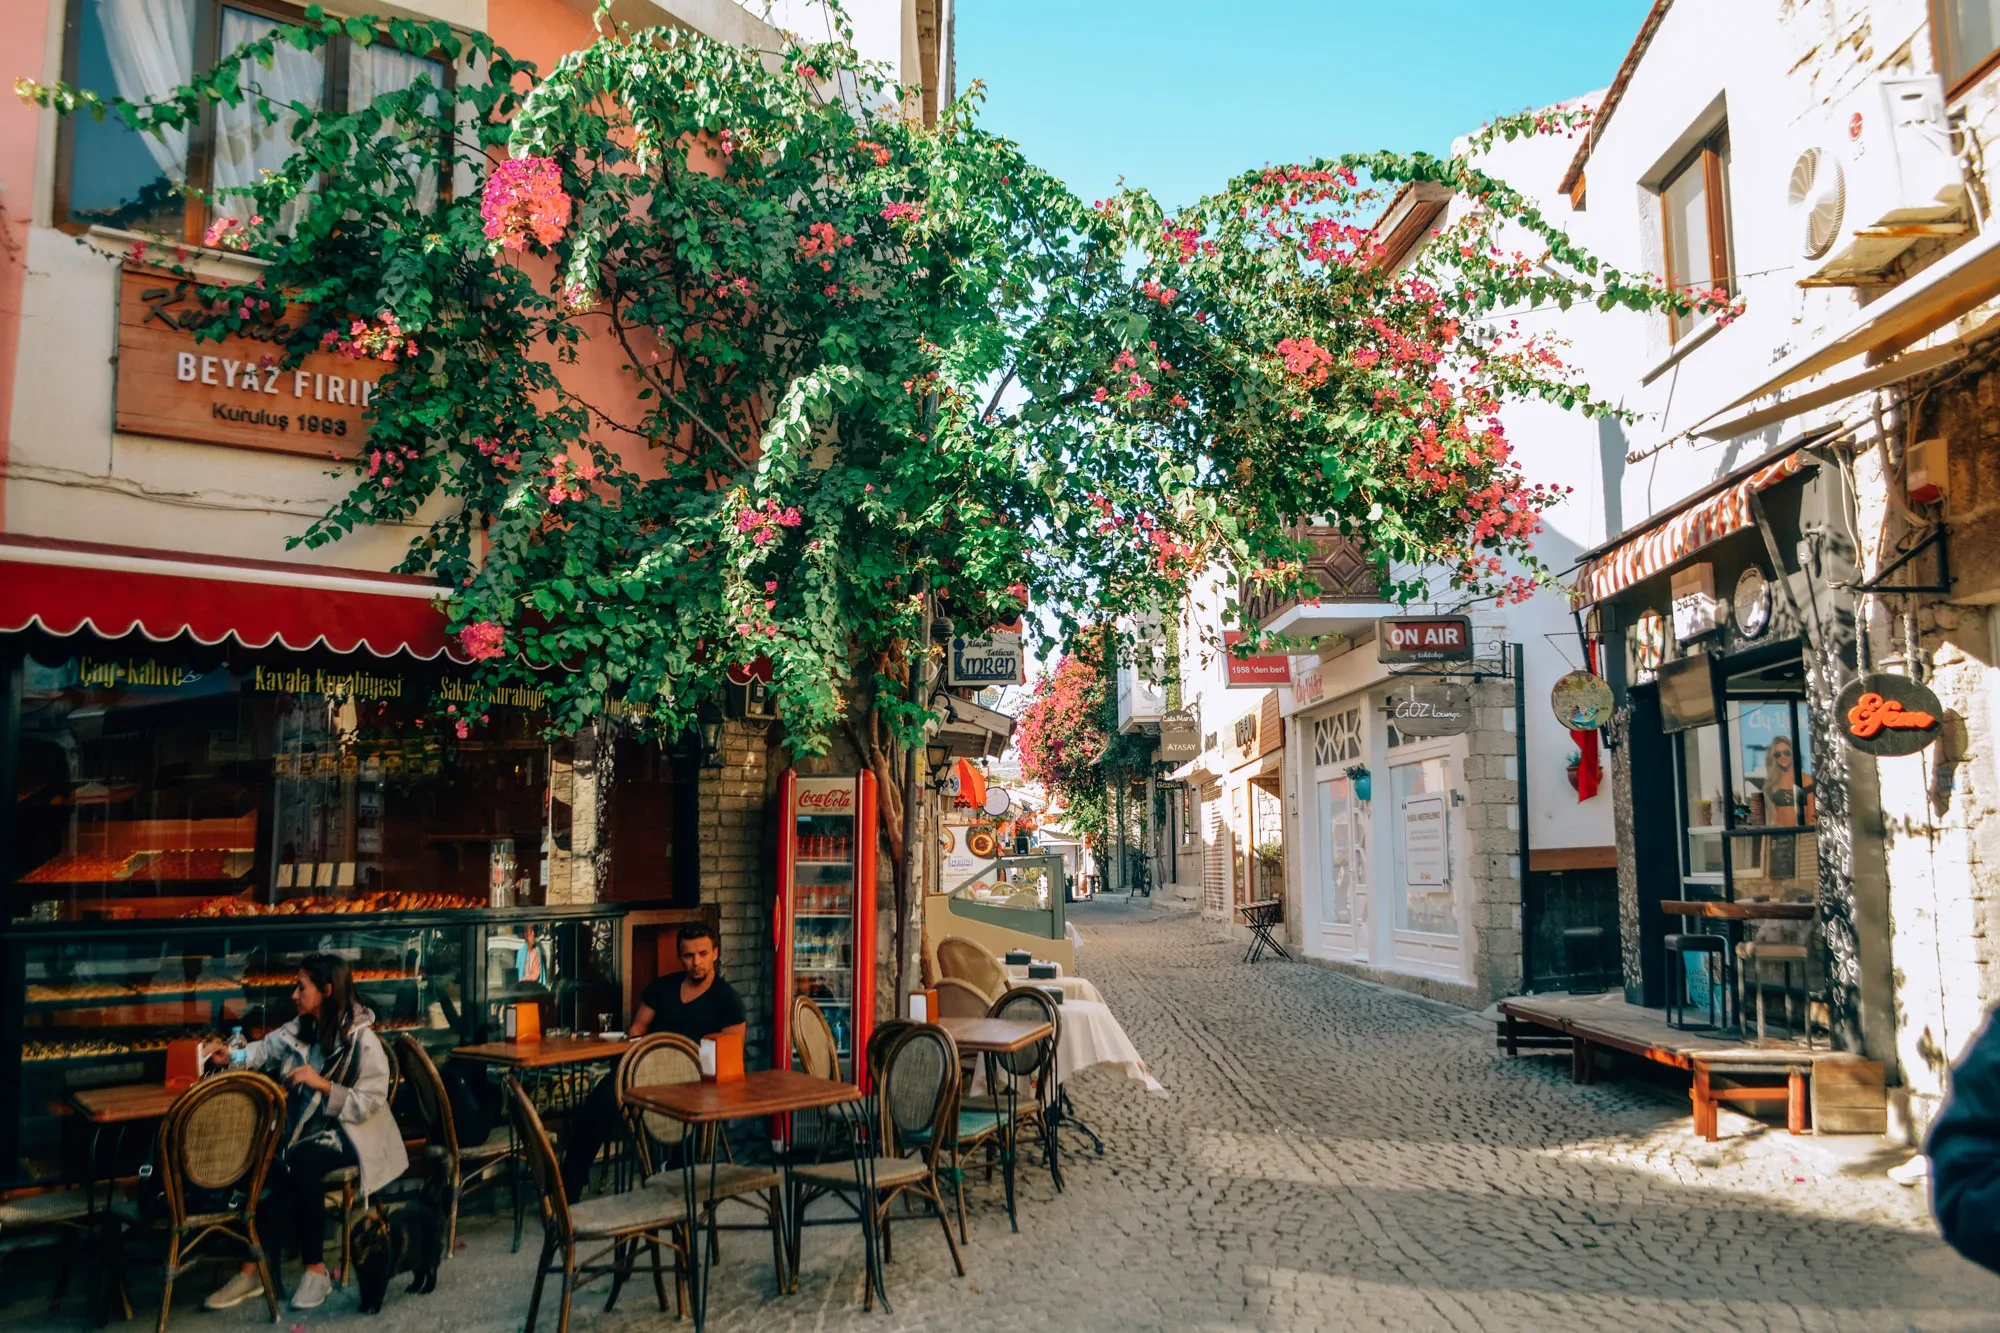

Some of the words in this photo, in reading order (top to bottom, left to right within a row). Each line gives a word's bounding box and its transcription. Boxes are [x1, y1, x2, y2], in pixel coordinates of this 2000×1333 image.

[177, 352, 280, 394] BEYAZ
[212, 403, 288, 431] Kuruluş
[298, 415, 348, 436] 1993
[1391, 628, 1418, 645] ON
[1424, 628, 1459, 645] AIR
[255, 665, 310, 693] Kavala
[1232, 666, 1250, 674] 1958
